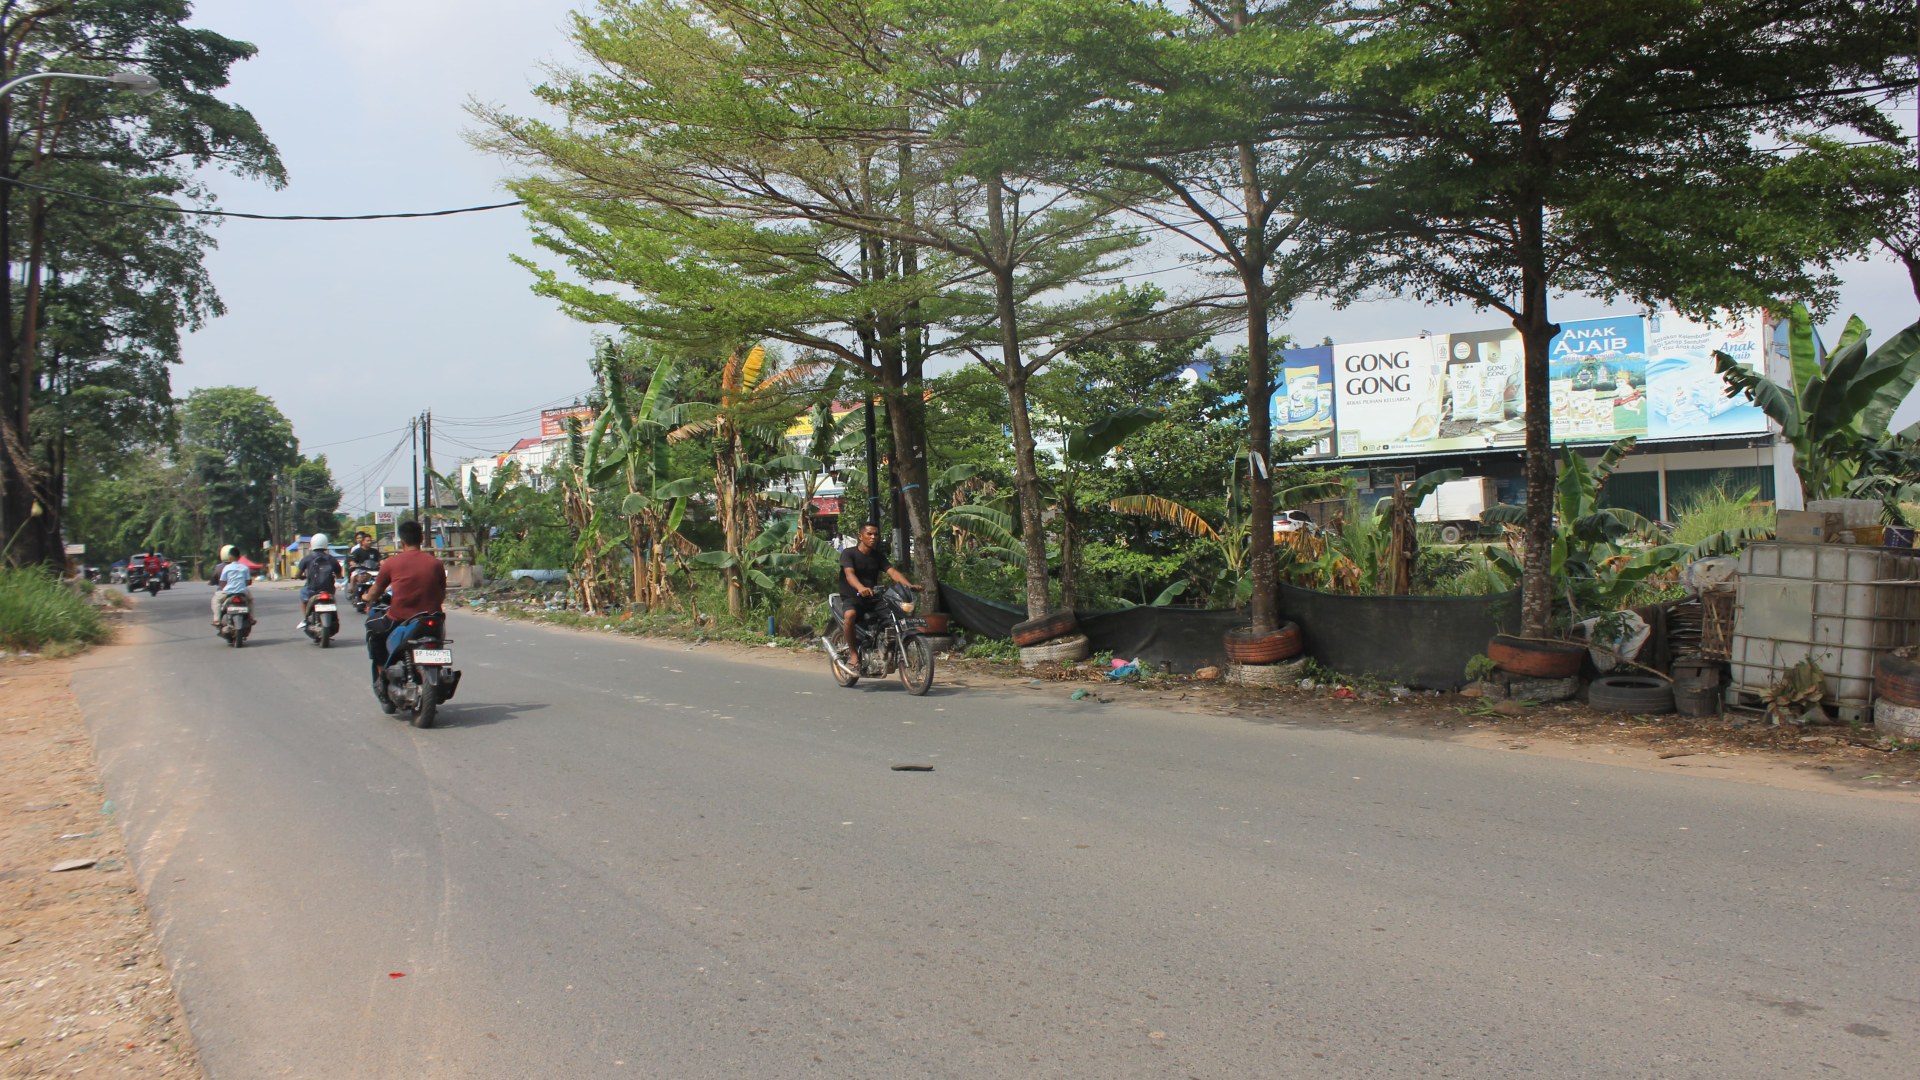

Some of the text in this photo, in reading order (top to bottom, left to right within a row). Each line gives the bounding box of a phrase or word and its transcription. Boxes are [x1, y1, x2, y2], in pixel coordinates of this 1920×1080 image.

[1563, 327, 1616, 340] ANAK
[1553, 337, 1627, 355] AJAIB
[1720, 341, 1756, 352] Anak
[1345, 351, 1409, 373] GONG
[1346, 374, 1411, 396] GONG
